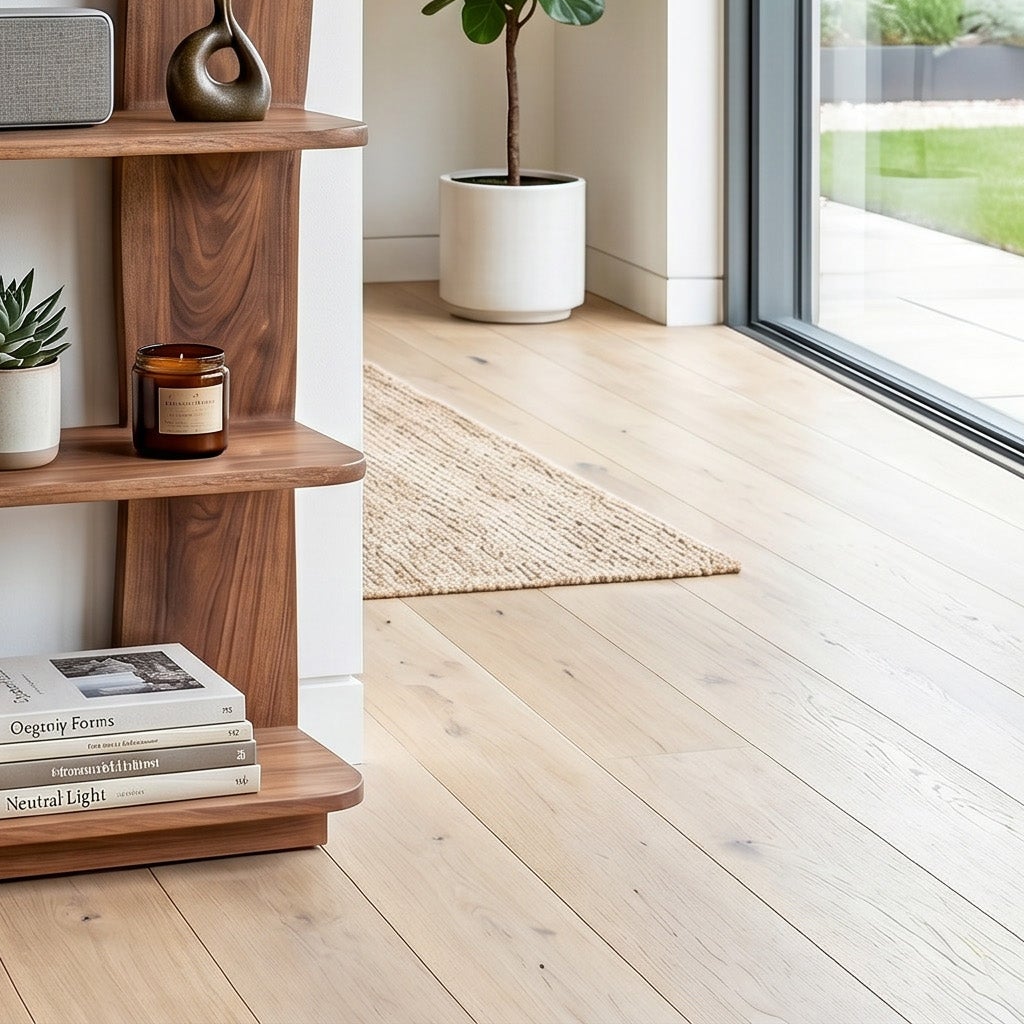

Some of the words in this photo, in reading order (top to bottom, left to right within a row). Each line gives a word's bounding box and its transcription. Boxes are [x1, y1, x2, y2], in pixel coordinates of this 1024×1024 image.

[72, 716, 115, 731] Forms
[6, 789, 63, 811] Neutral
[66, 787, 107, 808] Light
